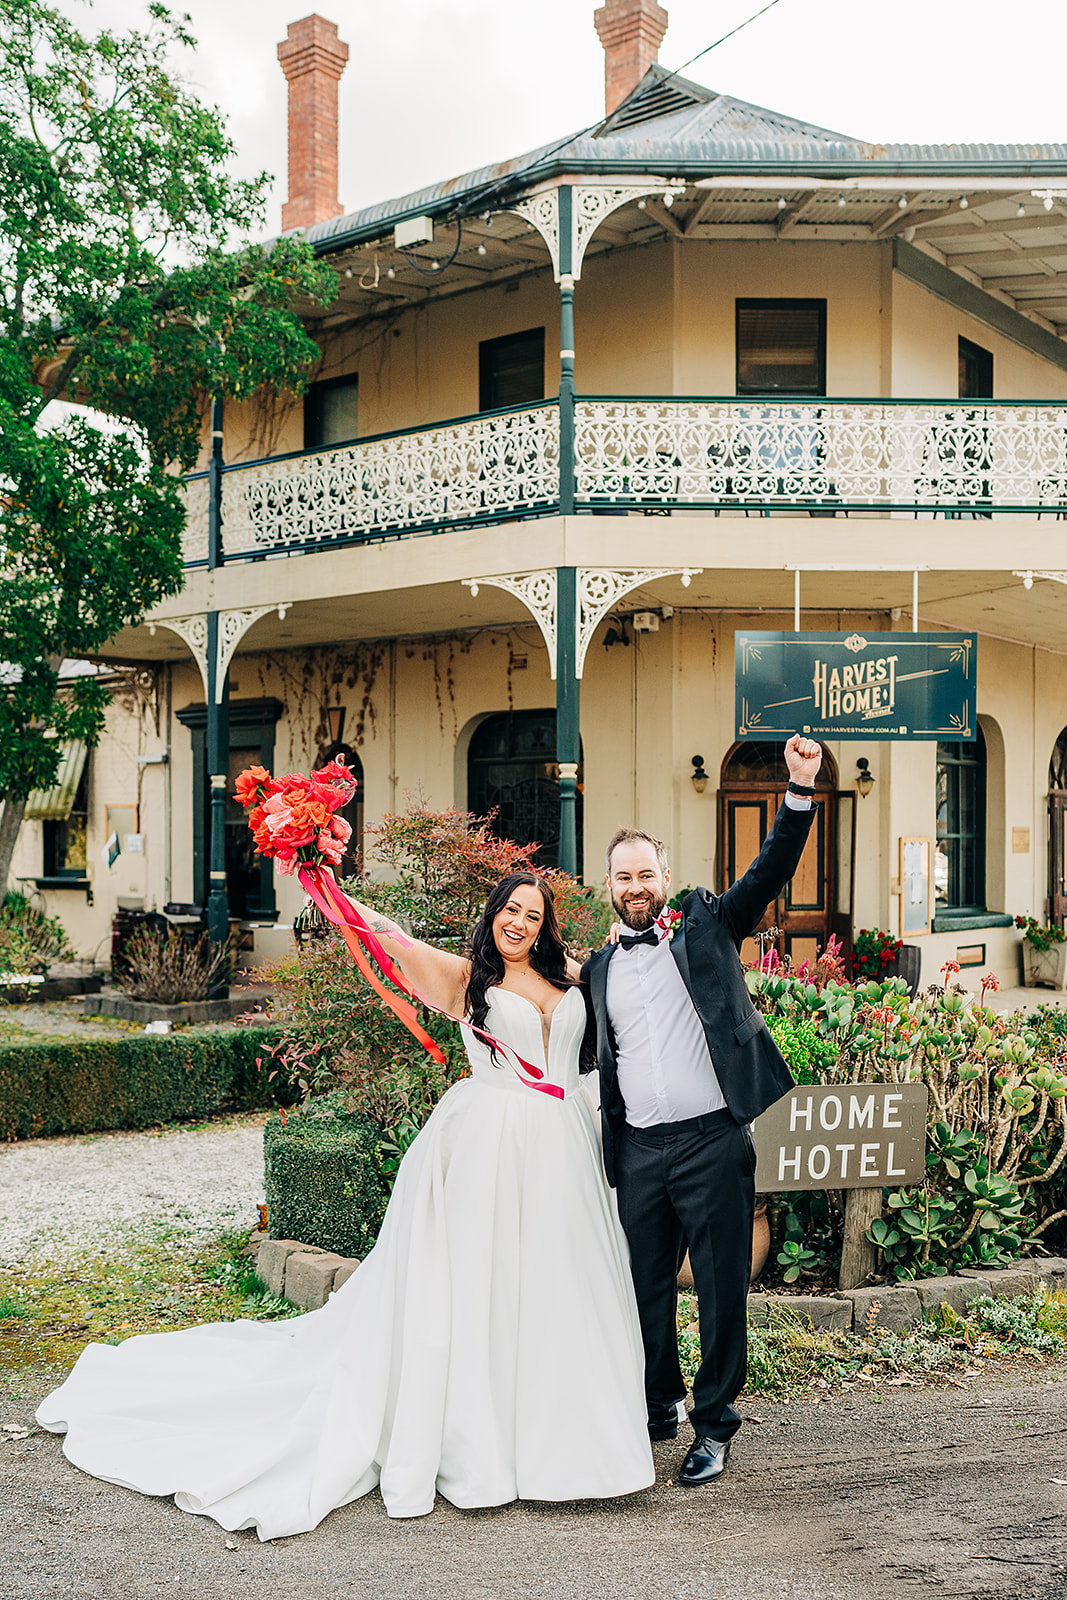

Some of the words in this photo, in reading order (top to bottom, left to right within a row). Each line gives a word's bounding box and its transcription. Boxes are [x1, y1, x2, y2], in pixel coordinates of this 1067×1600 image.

[812, 655, 898, 719] HARVEST
[828, 686, 882, 718] HOME
[789, 1094, 903, 1131] HOME
[778, 1142, 906, 1181] HOTEL
